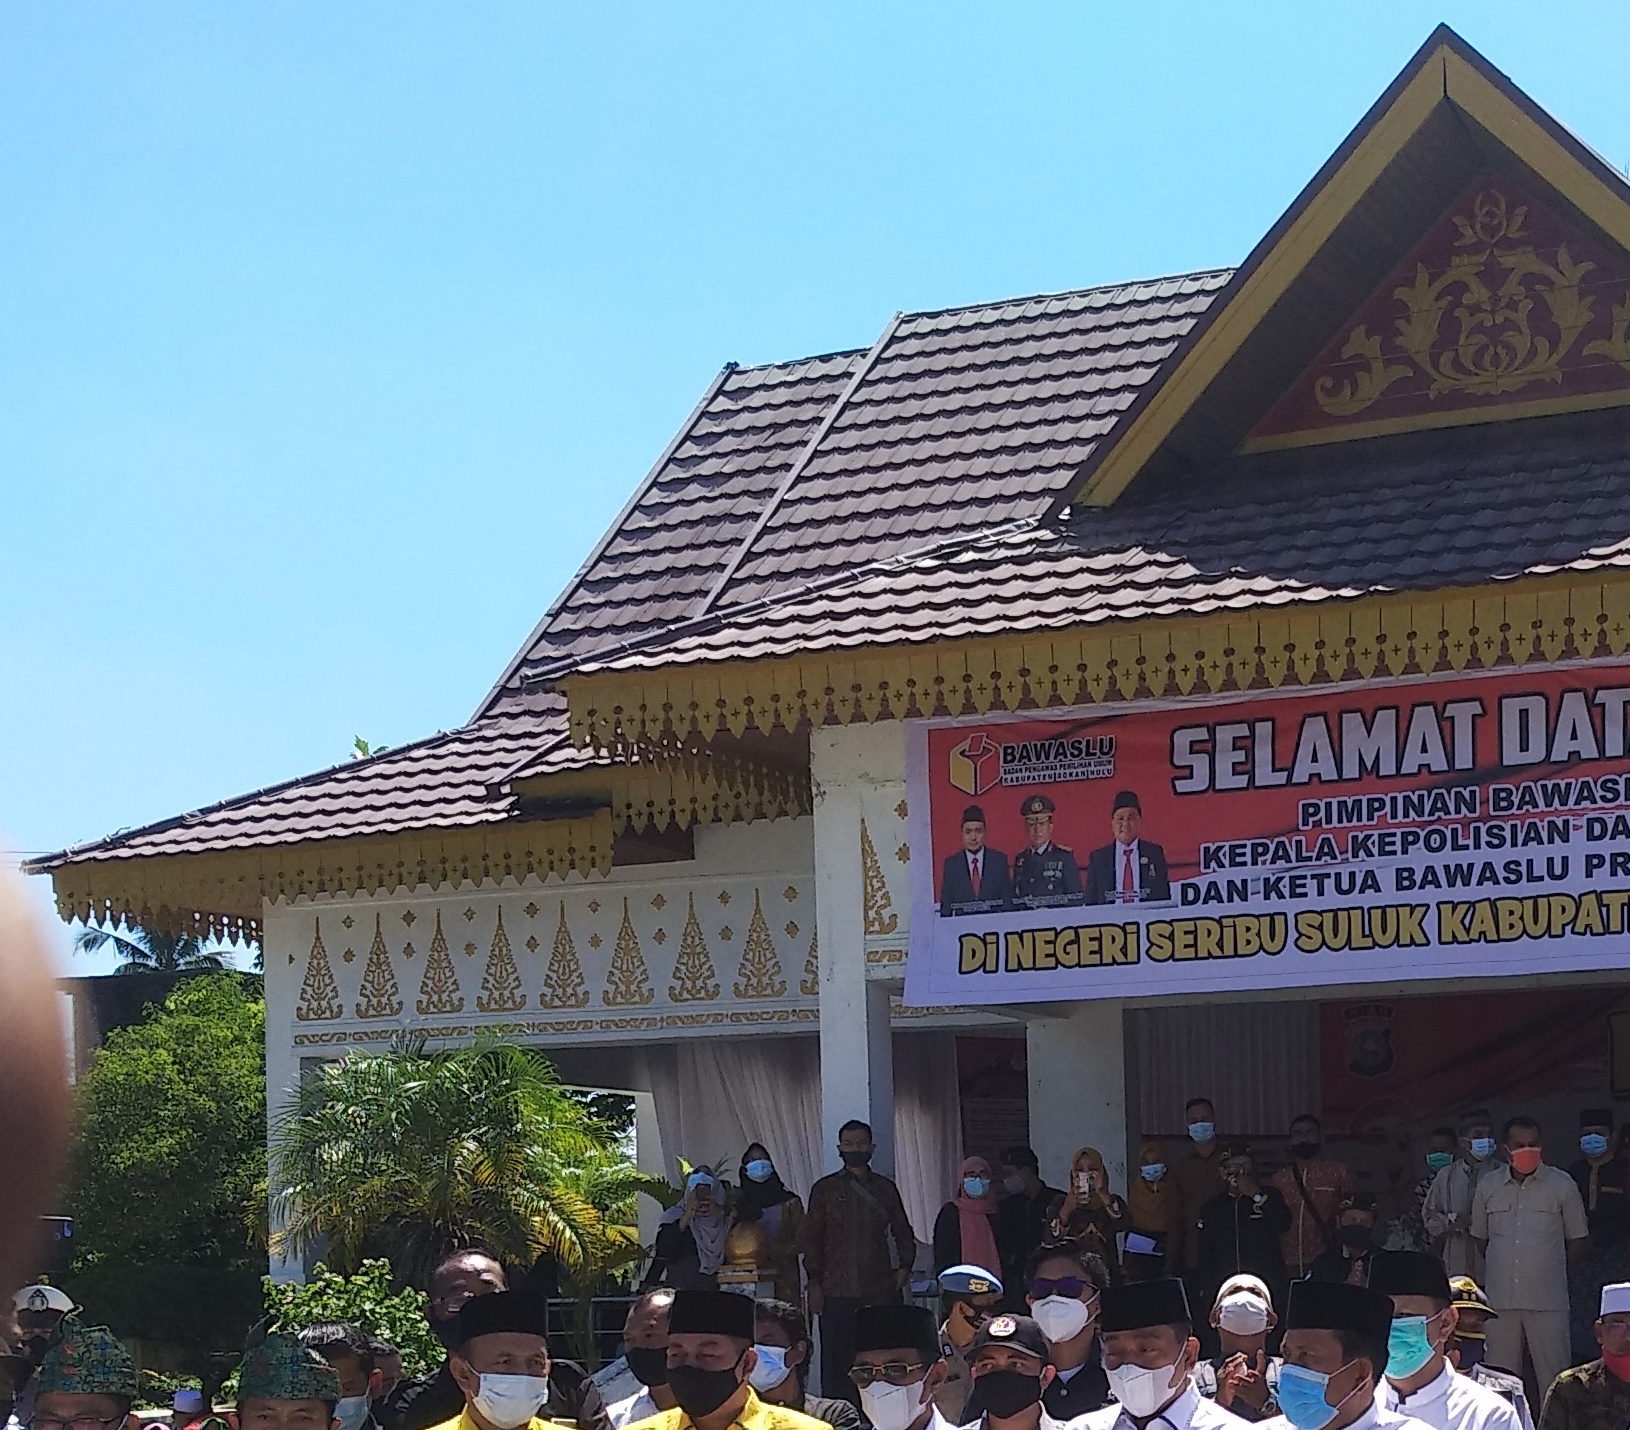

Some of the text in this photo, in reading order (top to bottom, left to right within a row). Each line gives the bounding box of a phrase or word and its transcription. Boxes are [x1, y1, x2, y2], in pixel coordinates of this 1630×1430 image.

[1002, 735, 1116, 766] BAWASLU
[1171, 698, 1485, 796] SELAMAT
[1301, 788, 1478, 828] PIMPINAN
[1202, 837, 1338, 871] KEPALA
[1351, 818, 1570, 859] KEPOLISIAN
[1180, 879, 1249, 907] DAN
[1263, 869, 1381, 900] KETUA
[1395, 856, 1569, 891] BAWASLU
[1296, 900, 1430, 952] SULUK
